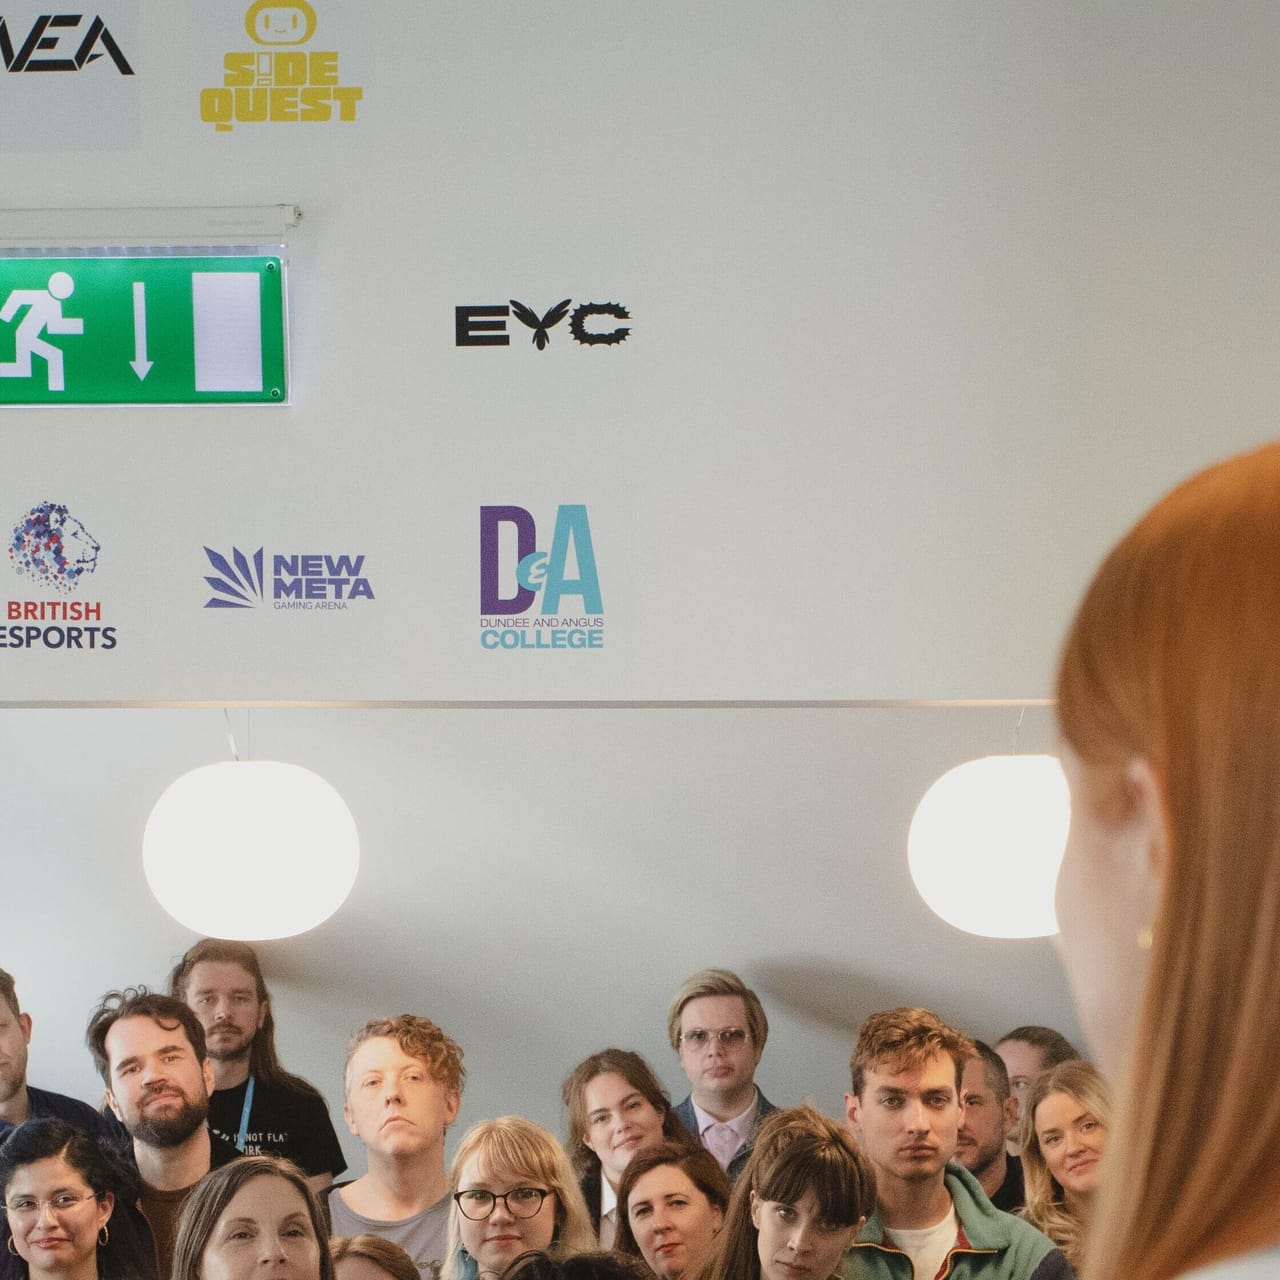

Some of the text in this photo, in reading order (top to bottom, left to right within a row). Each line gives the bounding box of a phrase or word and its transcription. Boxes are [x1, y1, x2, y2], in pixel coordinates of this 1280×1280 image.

[200, 86, 363, 132] QUEST
[273, 555, 365, 577] NEW
[273, 577, 376, 600] META
[7, 601, 101, 621] BRITISH
[273, 601, 348, 610] GAMING ARENA
[480, 617, 604, 628] DUNDEE AND ANGUS
[480, 629, 604, 650] COLLEGE
